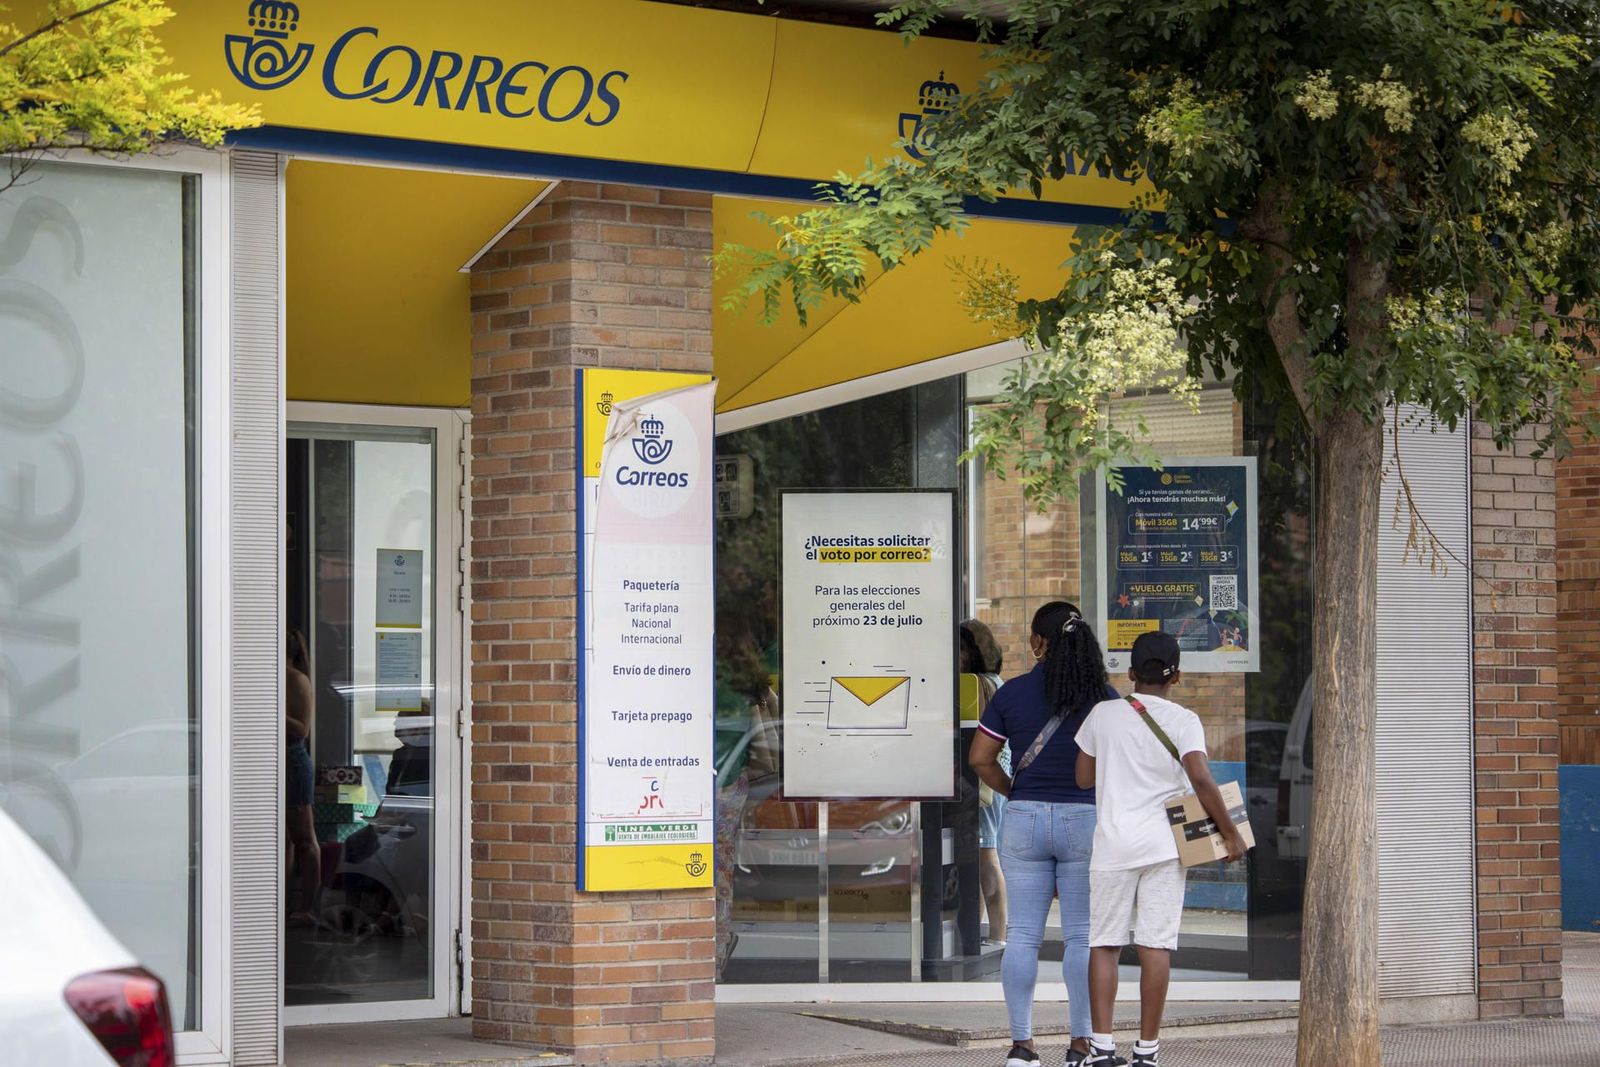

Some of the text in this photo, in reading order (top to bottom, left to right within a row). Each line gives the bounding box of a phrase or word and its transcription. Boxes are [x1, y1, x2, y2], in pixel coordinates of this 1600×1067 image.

[322, 26, 629, 127] CORREOS
[616, 466, 688, 488] Correos
[1127, 495, 1226, 504] ¡Ahora tendrás muchas más!
[1135, 518, 1156, 526] Móvil
[804, 534, 931, 550] ¿Necesitas solicitar
[805, 548, 930, 563] el voto por correo?
[623, 579, 679, 592] Paquetería
[815, 585, 921, 596] Para las elecciones
[1129, 584, 1195, 592] +VUELO GRATIS
[624, 602, 679, 615] Tarifa plana
[830, 600, 905, 613] generales del
[631, 618, 672, 629] Nacional
[813, 615, 923, 628] próximo 23 de julio
[621, 634, 682, 645] Internacional
[613, 664, 692, 676] Envío de dinero
[612, 711, 693, 724] Tarjeta prepago
[607, 755, 700, 767] Venta de entradas
